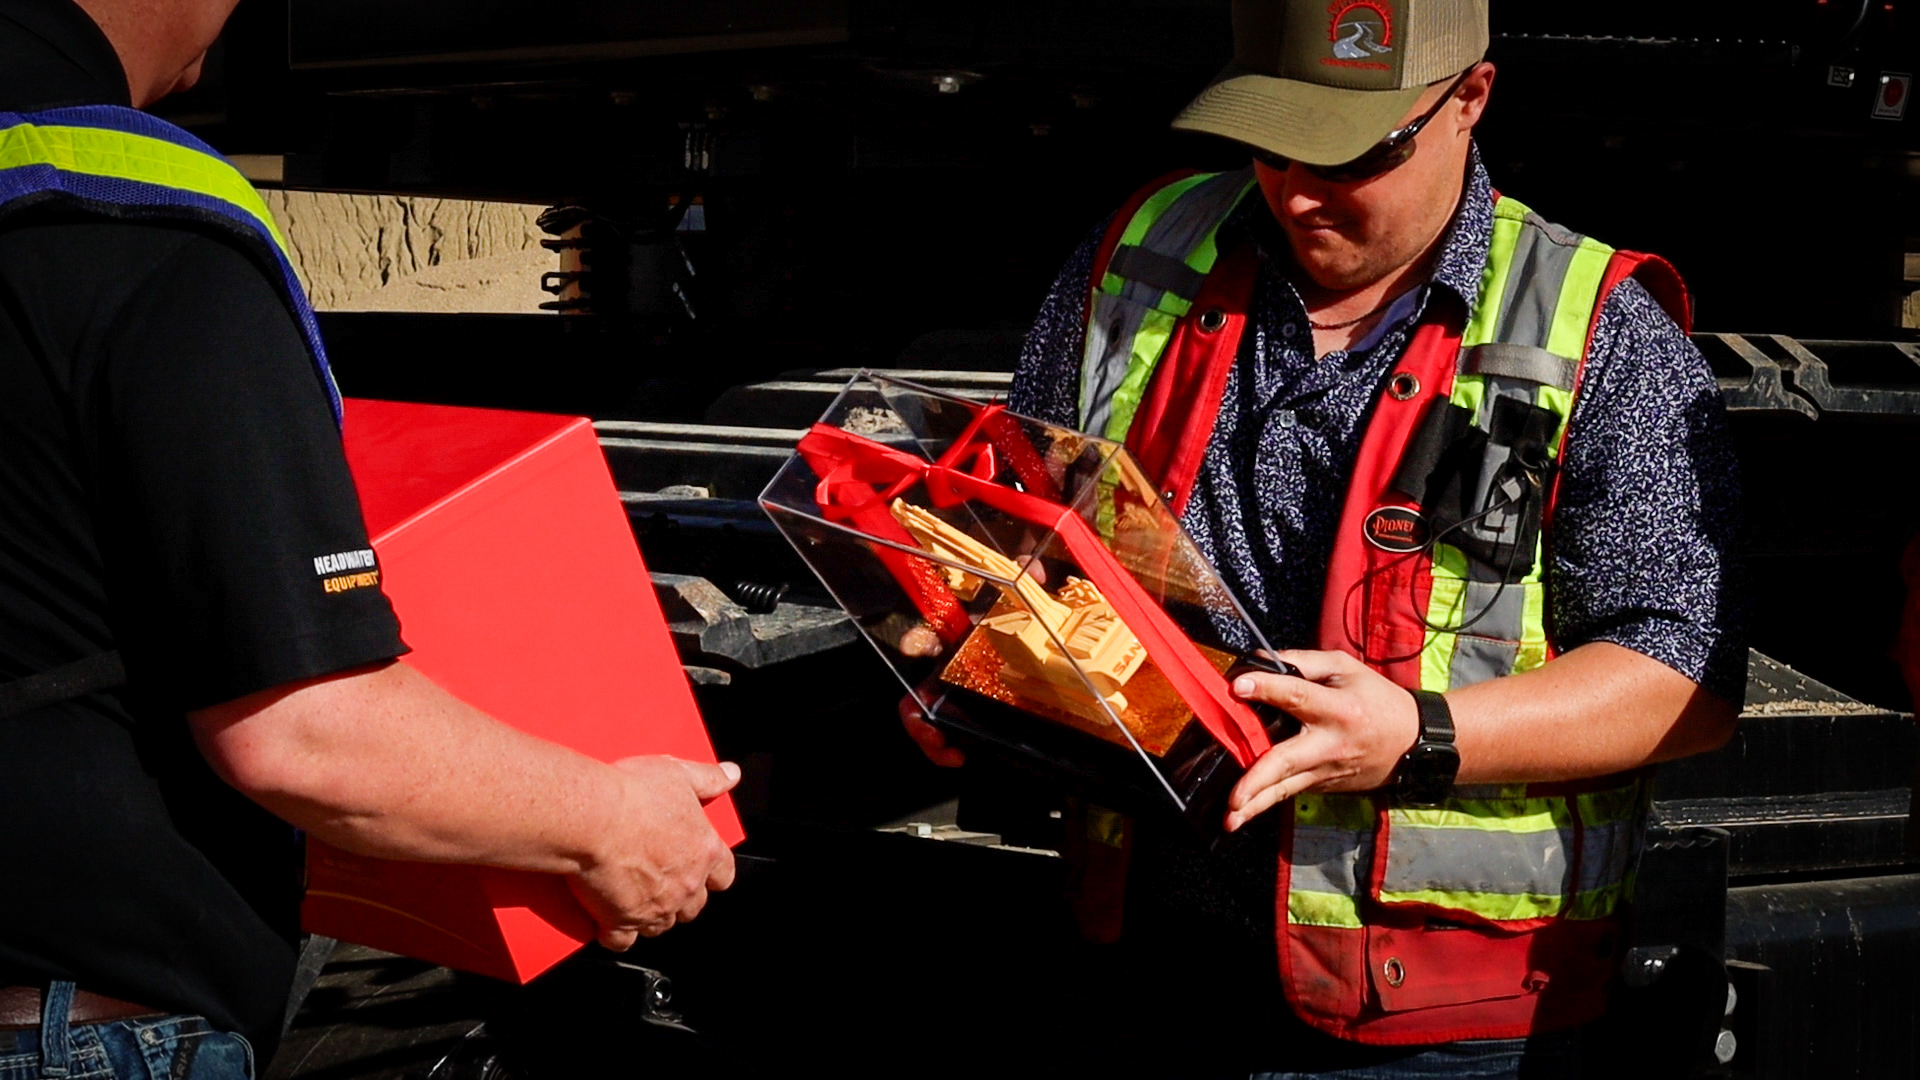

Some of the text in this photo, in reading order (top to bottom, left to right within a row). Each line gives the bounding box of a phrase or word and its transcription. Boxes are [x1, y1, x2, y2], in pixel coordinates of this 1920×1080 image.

[1373, 515, 1415, 536] PIONE
[314, 549, 375, 575] HEADWATER
[323, 569, 379, 593] EQUIPMENT
[1112, 641, 1142, 677] SAN
